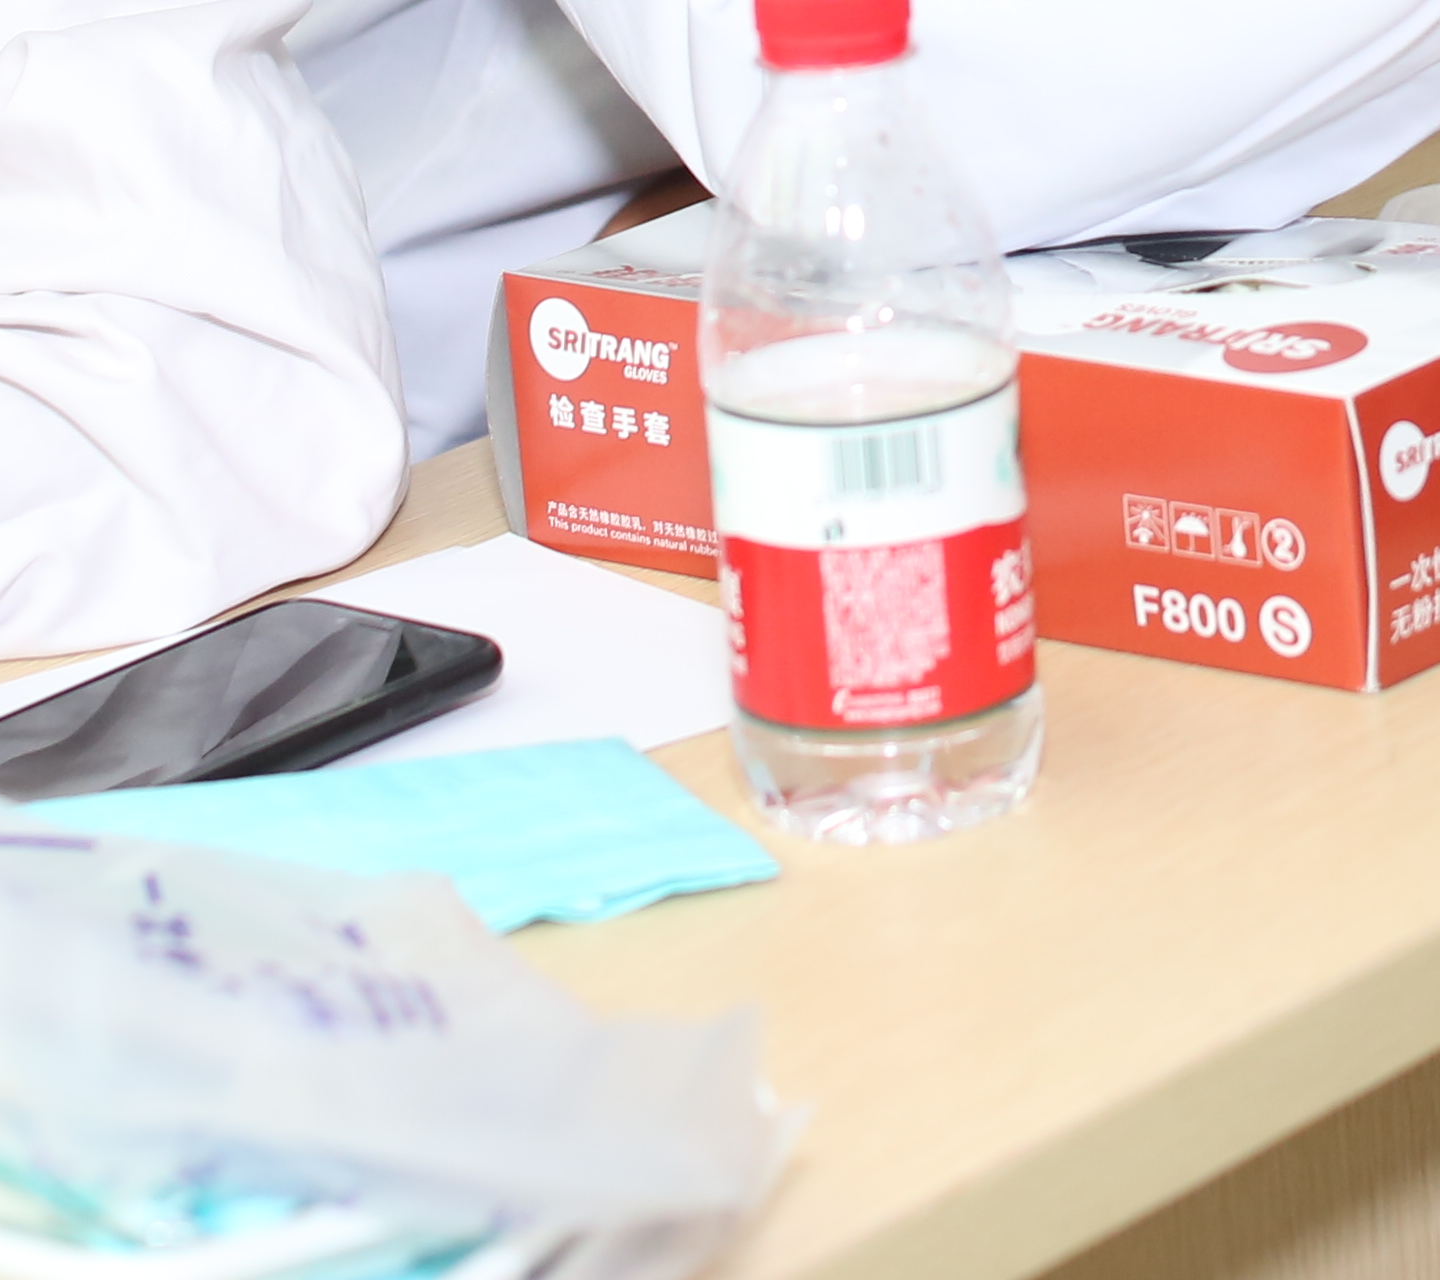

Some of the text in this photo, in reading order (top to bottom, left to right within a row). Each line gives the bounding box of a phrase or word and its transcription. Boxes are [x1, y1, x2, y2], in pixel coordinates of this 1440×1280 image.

[623, 364, 668, 385] GLOVES
[548, 393, 672, 447] 检查手套
[548, 515, 569, 531] This
[571, 520, 608, 539] product
[610, 528, 652, 546] contains
[653, 536, 688, 552] natural
[1133, 583, 1247, 643] F800
